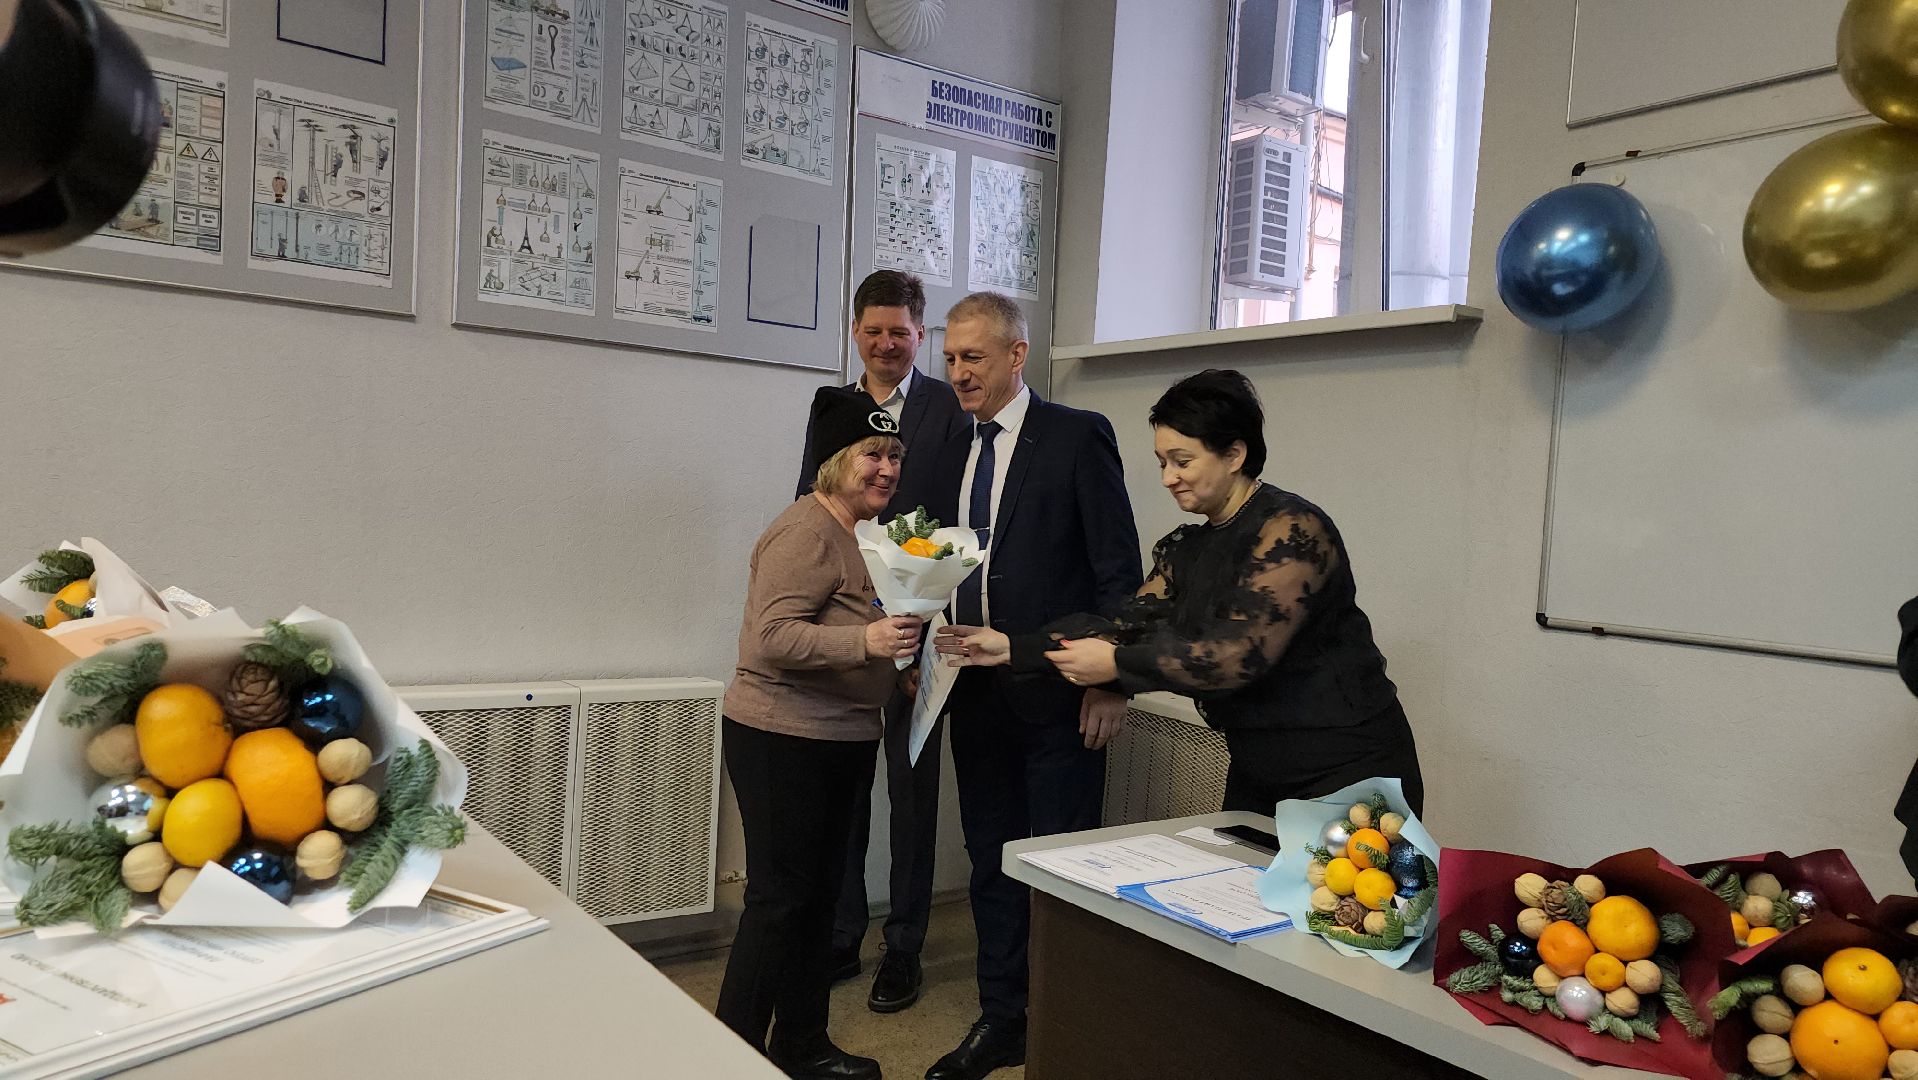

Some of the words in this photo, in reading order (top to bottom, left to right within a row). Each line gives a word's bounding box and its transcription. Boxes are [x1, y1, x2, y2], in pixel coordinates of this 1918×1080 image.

[925, 100, 1056, 151] ЭЛЕКТРОИНСТРУМЕНТОМ
[931, 79, 1002, 116] БЕЗОПАСНАЯ
[1004, 99, 1043, 127] РАБОТА
[1045, 110, 1053, 129] С
